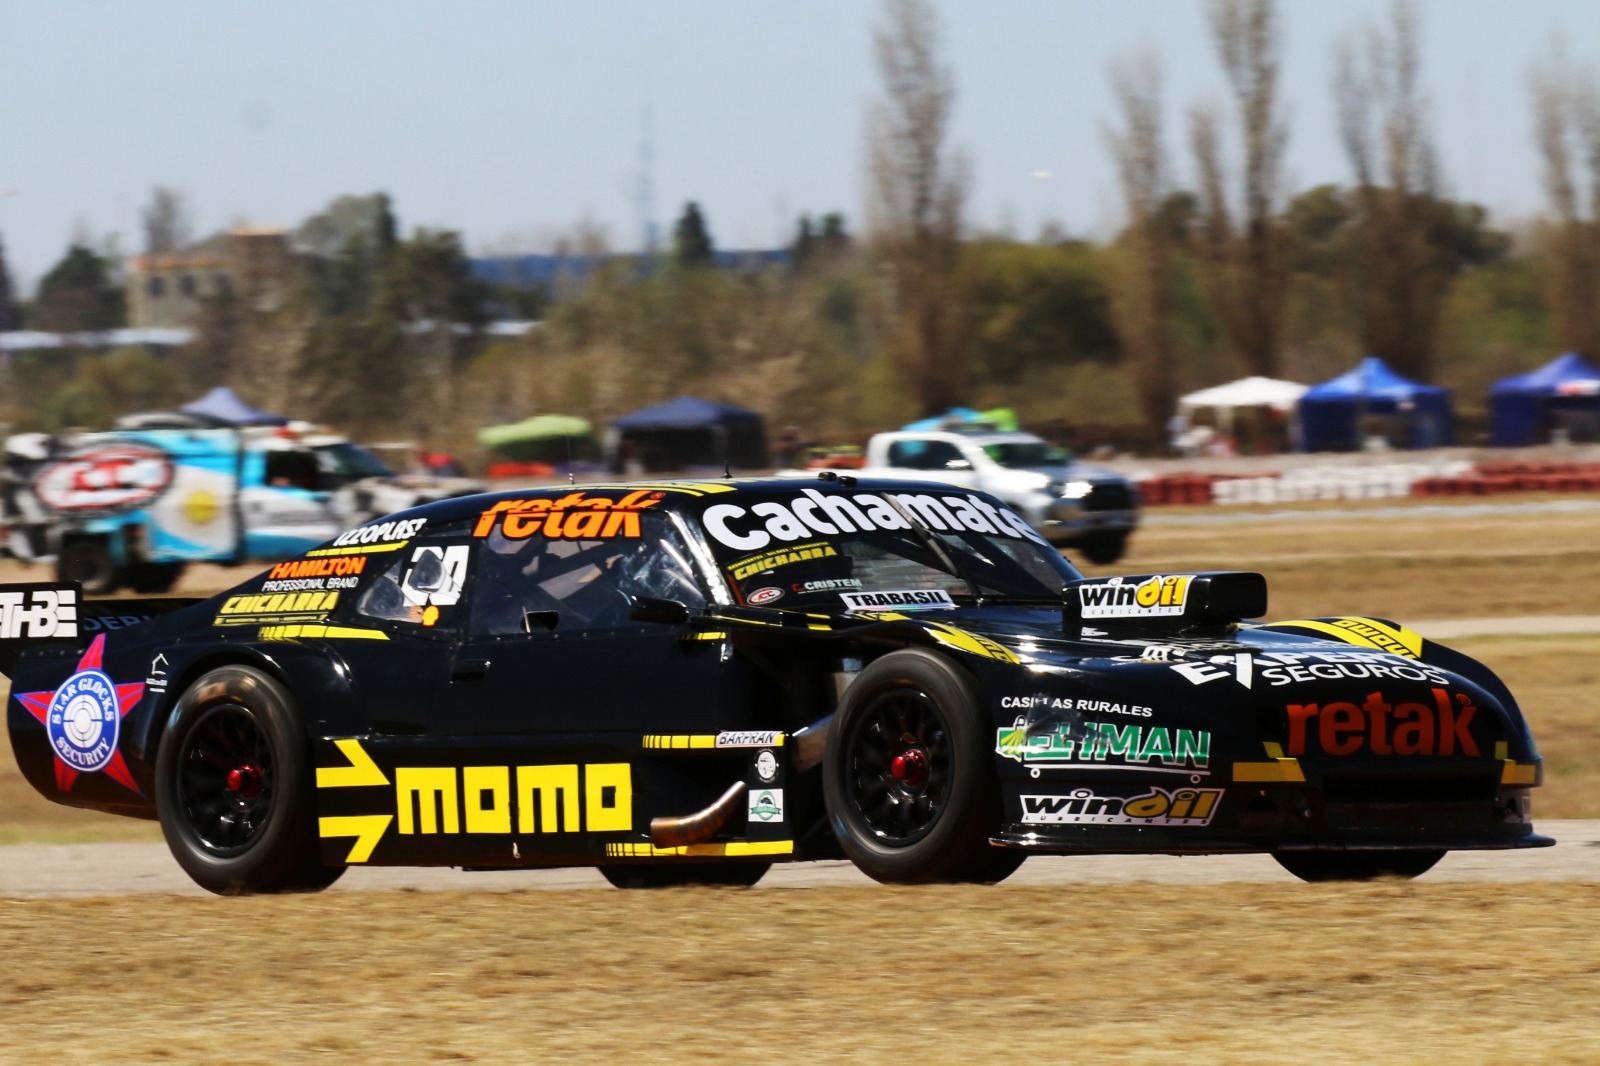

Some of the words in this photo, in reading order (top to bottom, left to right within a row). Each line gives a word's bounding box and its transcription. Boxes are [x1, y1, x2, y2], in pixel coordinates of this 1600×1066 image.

[473, 490, 661, 538] retak
[702, 489, 1048, 551] Cachamate
[269, 557, 367, 579] HAMILTON
[261, 578, 325, 592] PROFESSIONAL
[326, 577, 359, 589] BRAND
[850, 590, 950, 606] TRABASIL
[1262, 663, 1450, 686] SEGUROS
[52, 684, 77, 724] STAR
[78, 678, 114, 721] GLOCKS
[1001, 696, 1073, 709] CASIAS
[1076, 699, 1153, 717] RURALES
[1286, 688, 1482, 758] retak
[56, 737, 110, 765] SECURITY
[1025, 815, 1209, 825] LUBRICANTES
